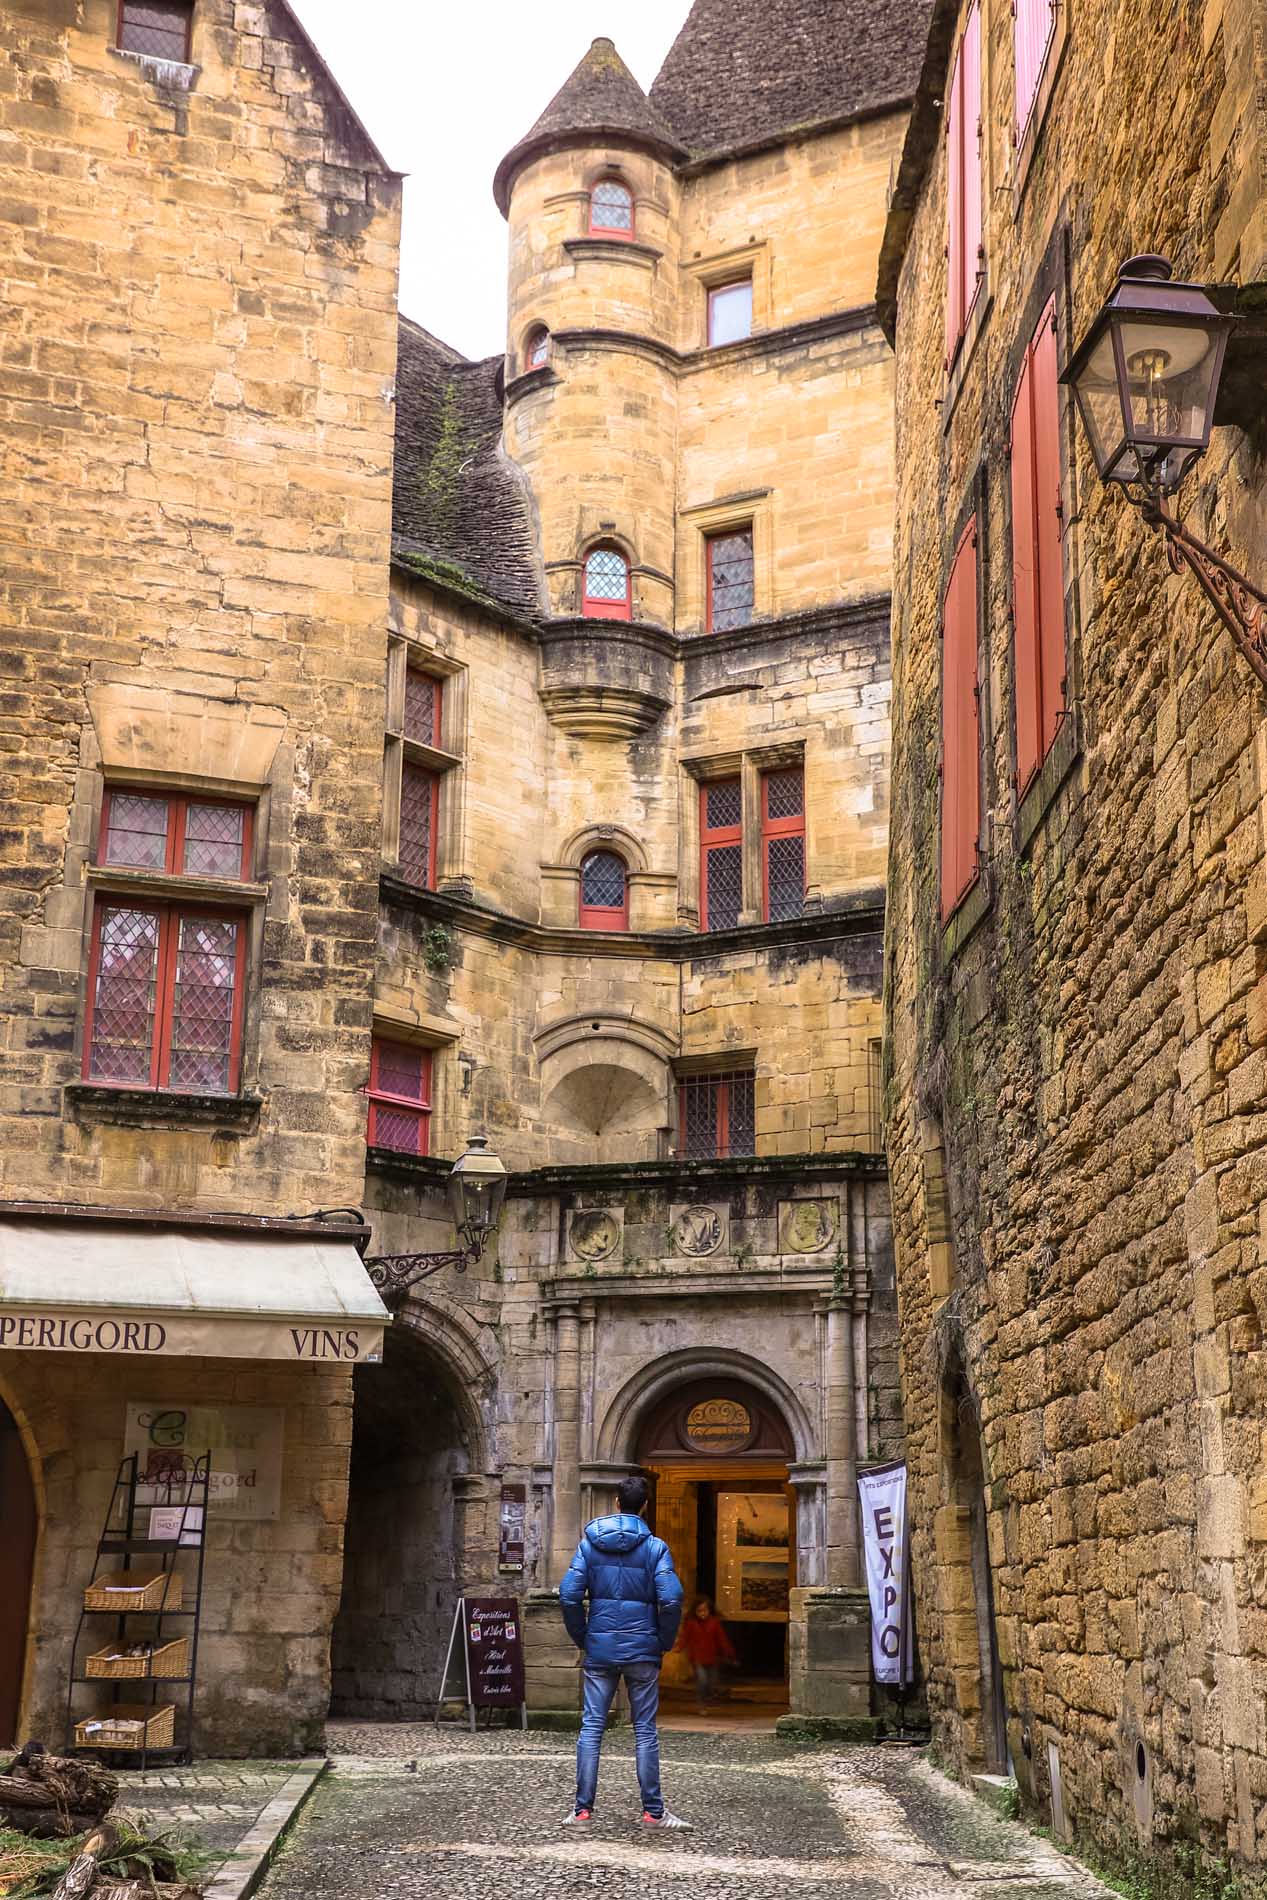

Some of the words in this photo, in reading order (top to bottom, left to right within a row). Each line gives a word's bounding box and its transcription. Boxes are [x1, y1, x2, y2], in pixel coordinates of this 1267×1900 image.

[0, 1317, 166, 1351] PERIGORD
[289, 1328, 359, 1360] VINS
[873, 1506, 900, 1659] EXPO
[472, 1607, 511, 1622] Expositions
